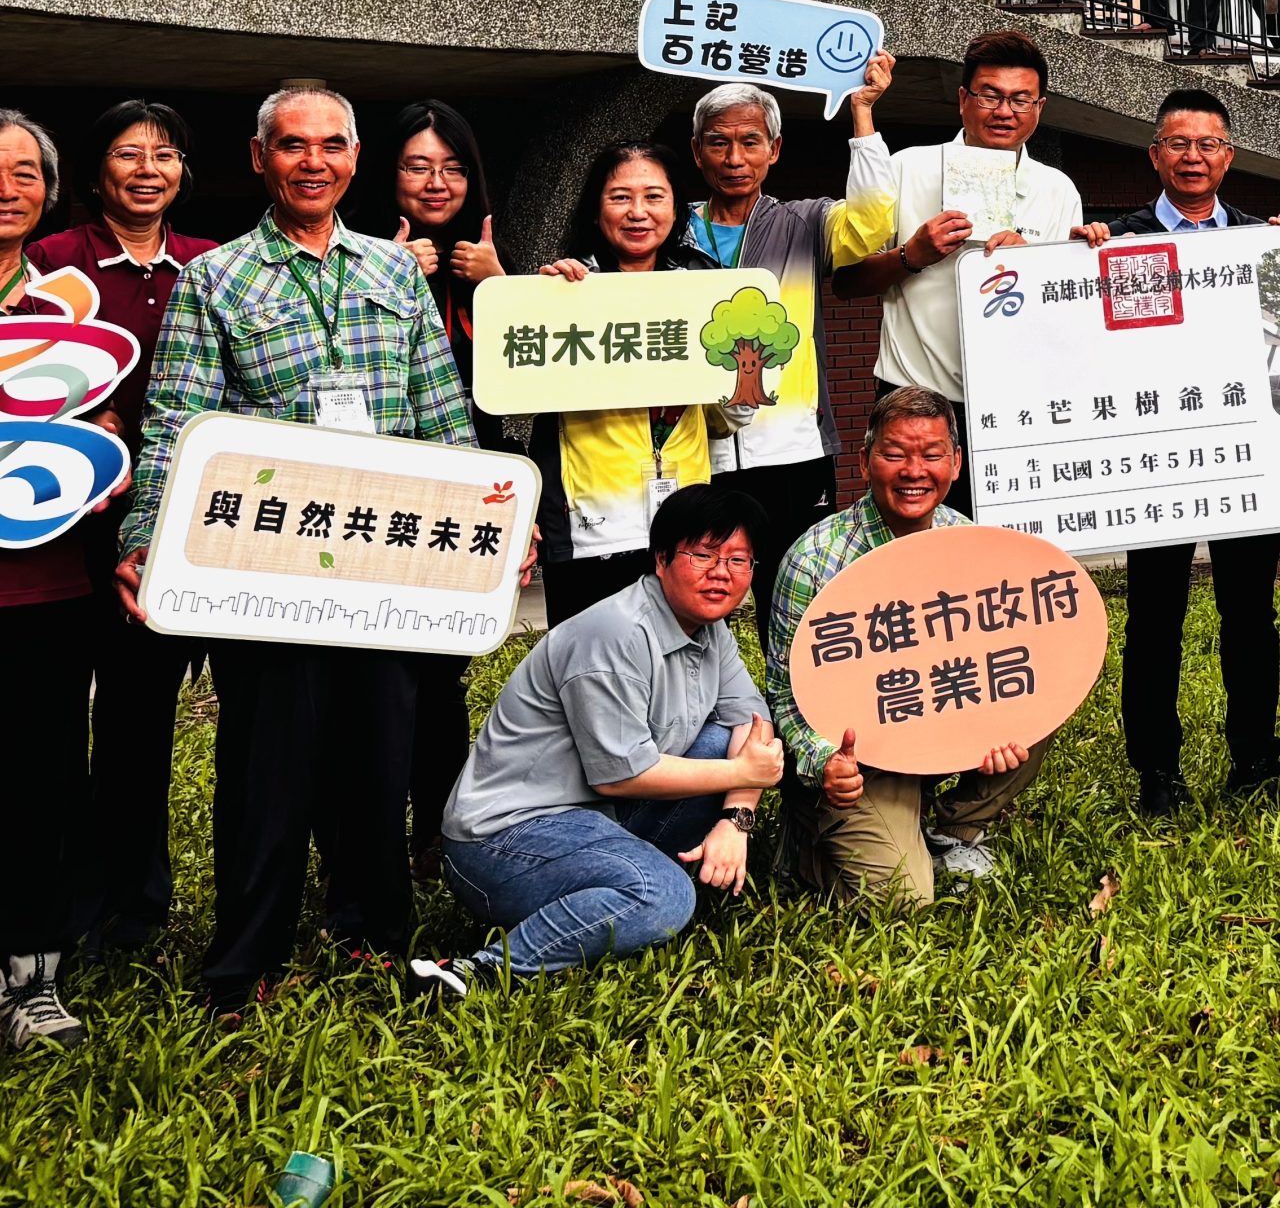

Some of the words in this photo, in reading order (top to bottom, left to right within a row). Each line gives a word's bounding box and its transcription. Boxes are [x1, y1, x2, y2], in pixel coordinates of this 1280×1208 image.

[662, 34, 807, 78] 百佑營造
[1041, 263, 1255, 304] 高雄市特定紀念樹木身分證
[503, 318, 689, 369] 樹木保護
[980, 409, 1034, 430] 姓名
[1047, 381, 1247, 425] 芒果樹爺爺
[984, 457, 1041, 478] 出生
[985, 475, 1041, 494] 年月日
[204, 489, 503, 557] 與自然共築未來
[808, 569, 1079, 668] 高雄市政府
[875, 645, 1035, 724] 農業局
